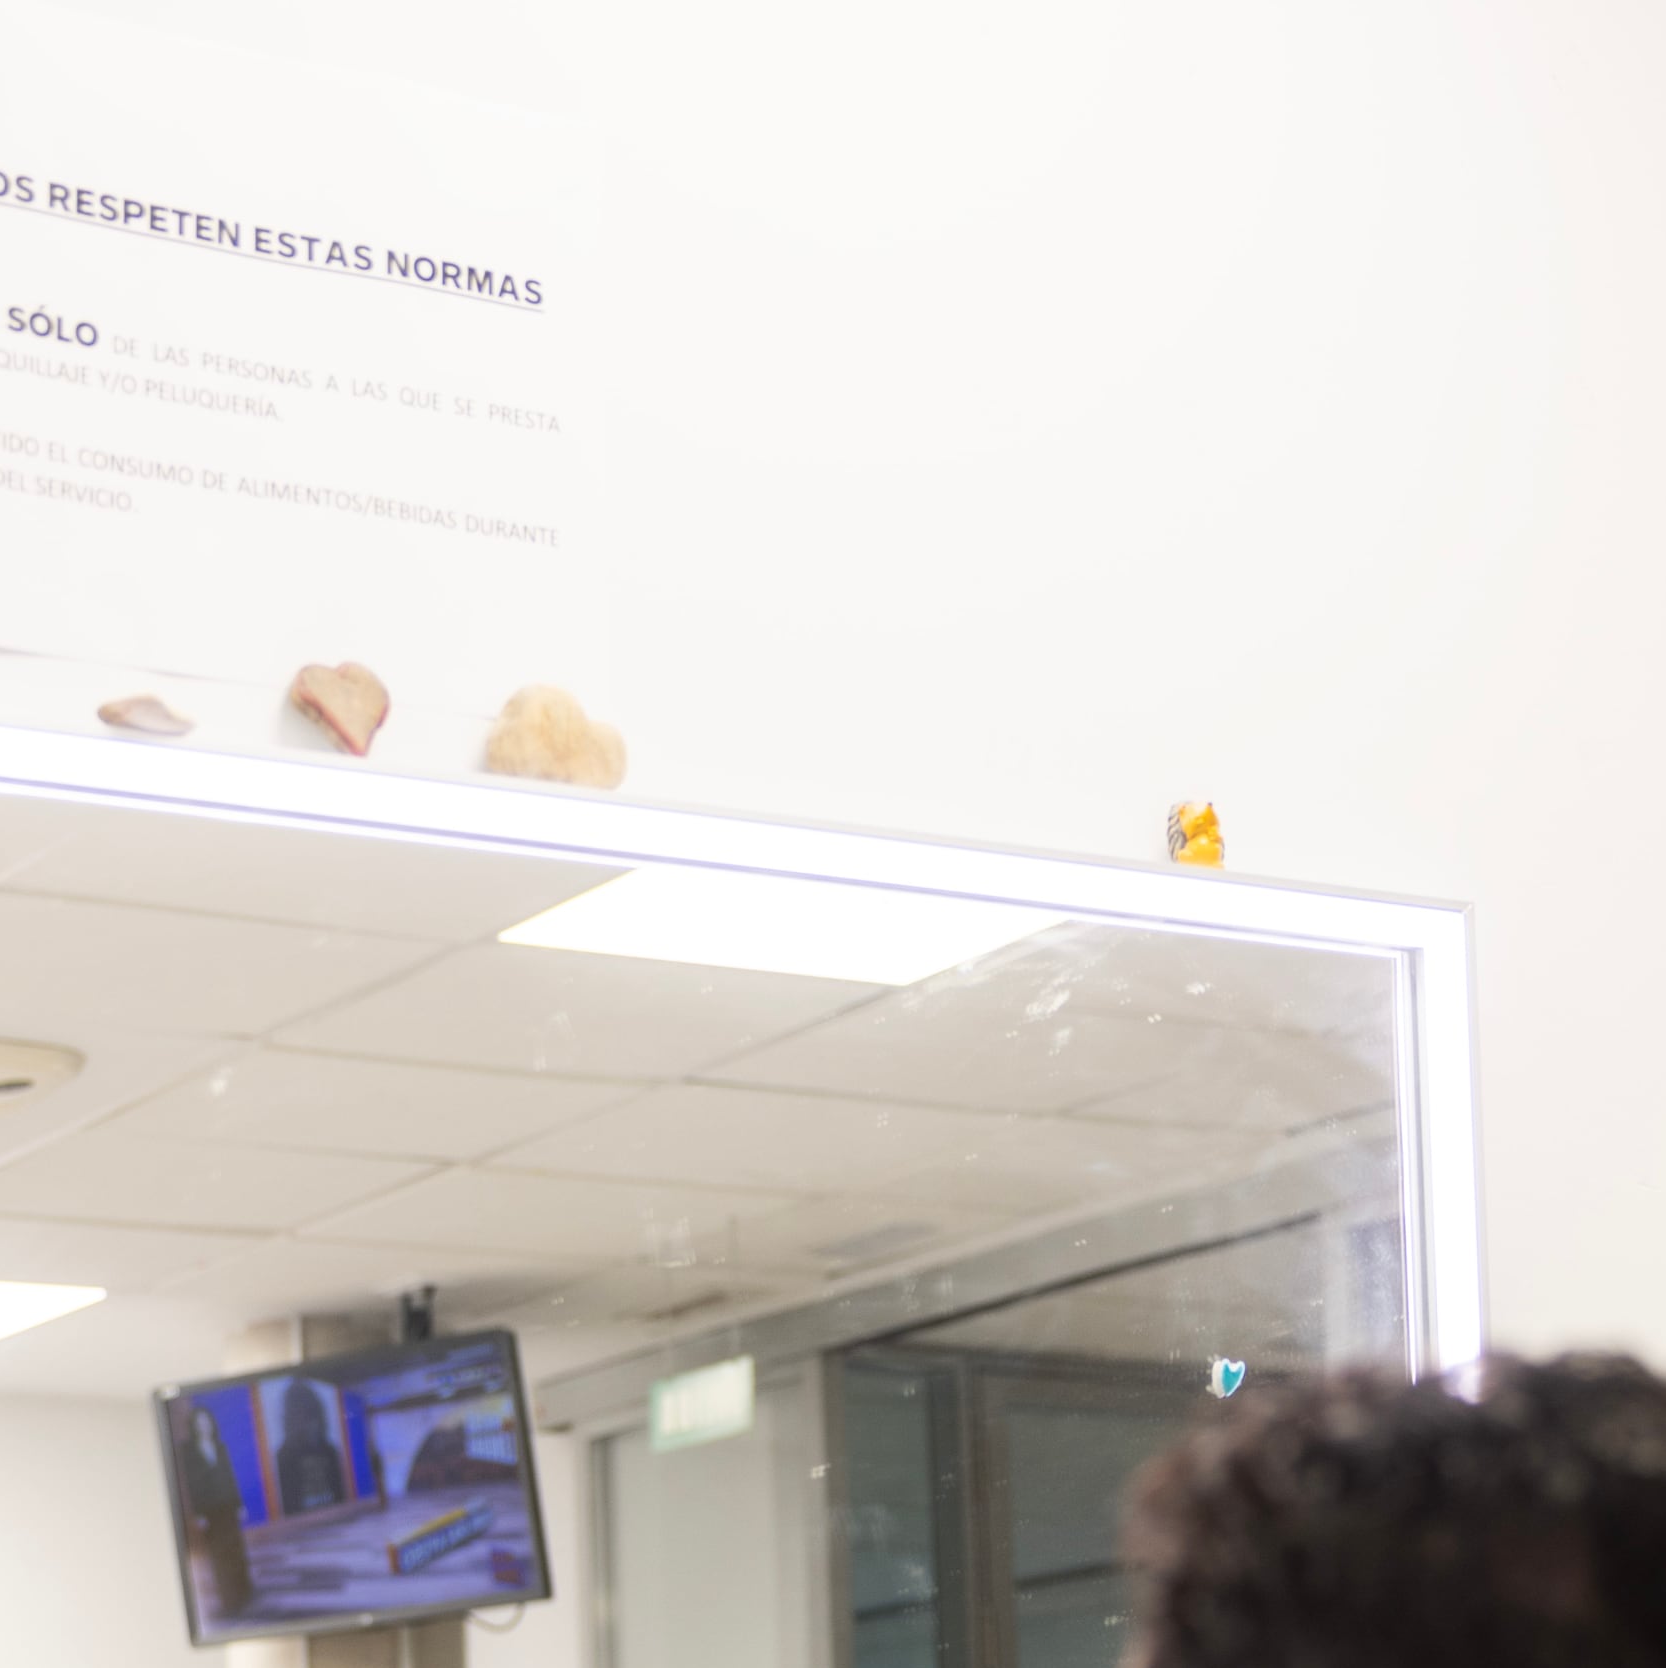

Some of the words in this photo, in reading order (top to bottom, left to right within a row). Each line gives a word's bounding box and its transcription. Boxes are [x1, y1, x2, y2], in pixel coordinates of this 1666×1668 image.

[48, 182, 240, 247] RESPETEN
[254, 227, 373, 271] ESTAS
[386, 249, 543, 305] NORMAS
[6, 304, 99, 348] SÓLO
[112, 335, 140, 358] DE
[152, 341, 190, 368] LAS
[202, 351, 313, 389] PERSONAS
[325, 373, 340, 393] A
[352, 377, 389, 401] LAS
[399, 386, 442, 413] QUE
[454, 396, 476, 418] SE
[488, 403, 562, 433] PRESTA
[98, 369, 137, 396] Y/O
[145, 377, 284, 421] PELUQUERÍA.
[36, 477, 140, 513] SERVICIO.
[48, 441, 71, 465] EL
[77, 447, 194, 486] CONSUMO
[202, 469, 229, 492] DE
[237, 475, 458, 530] ALIMENTOS/BEBIDAS
[464, 514, 561, 548] DURANTE
